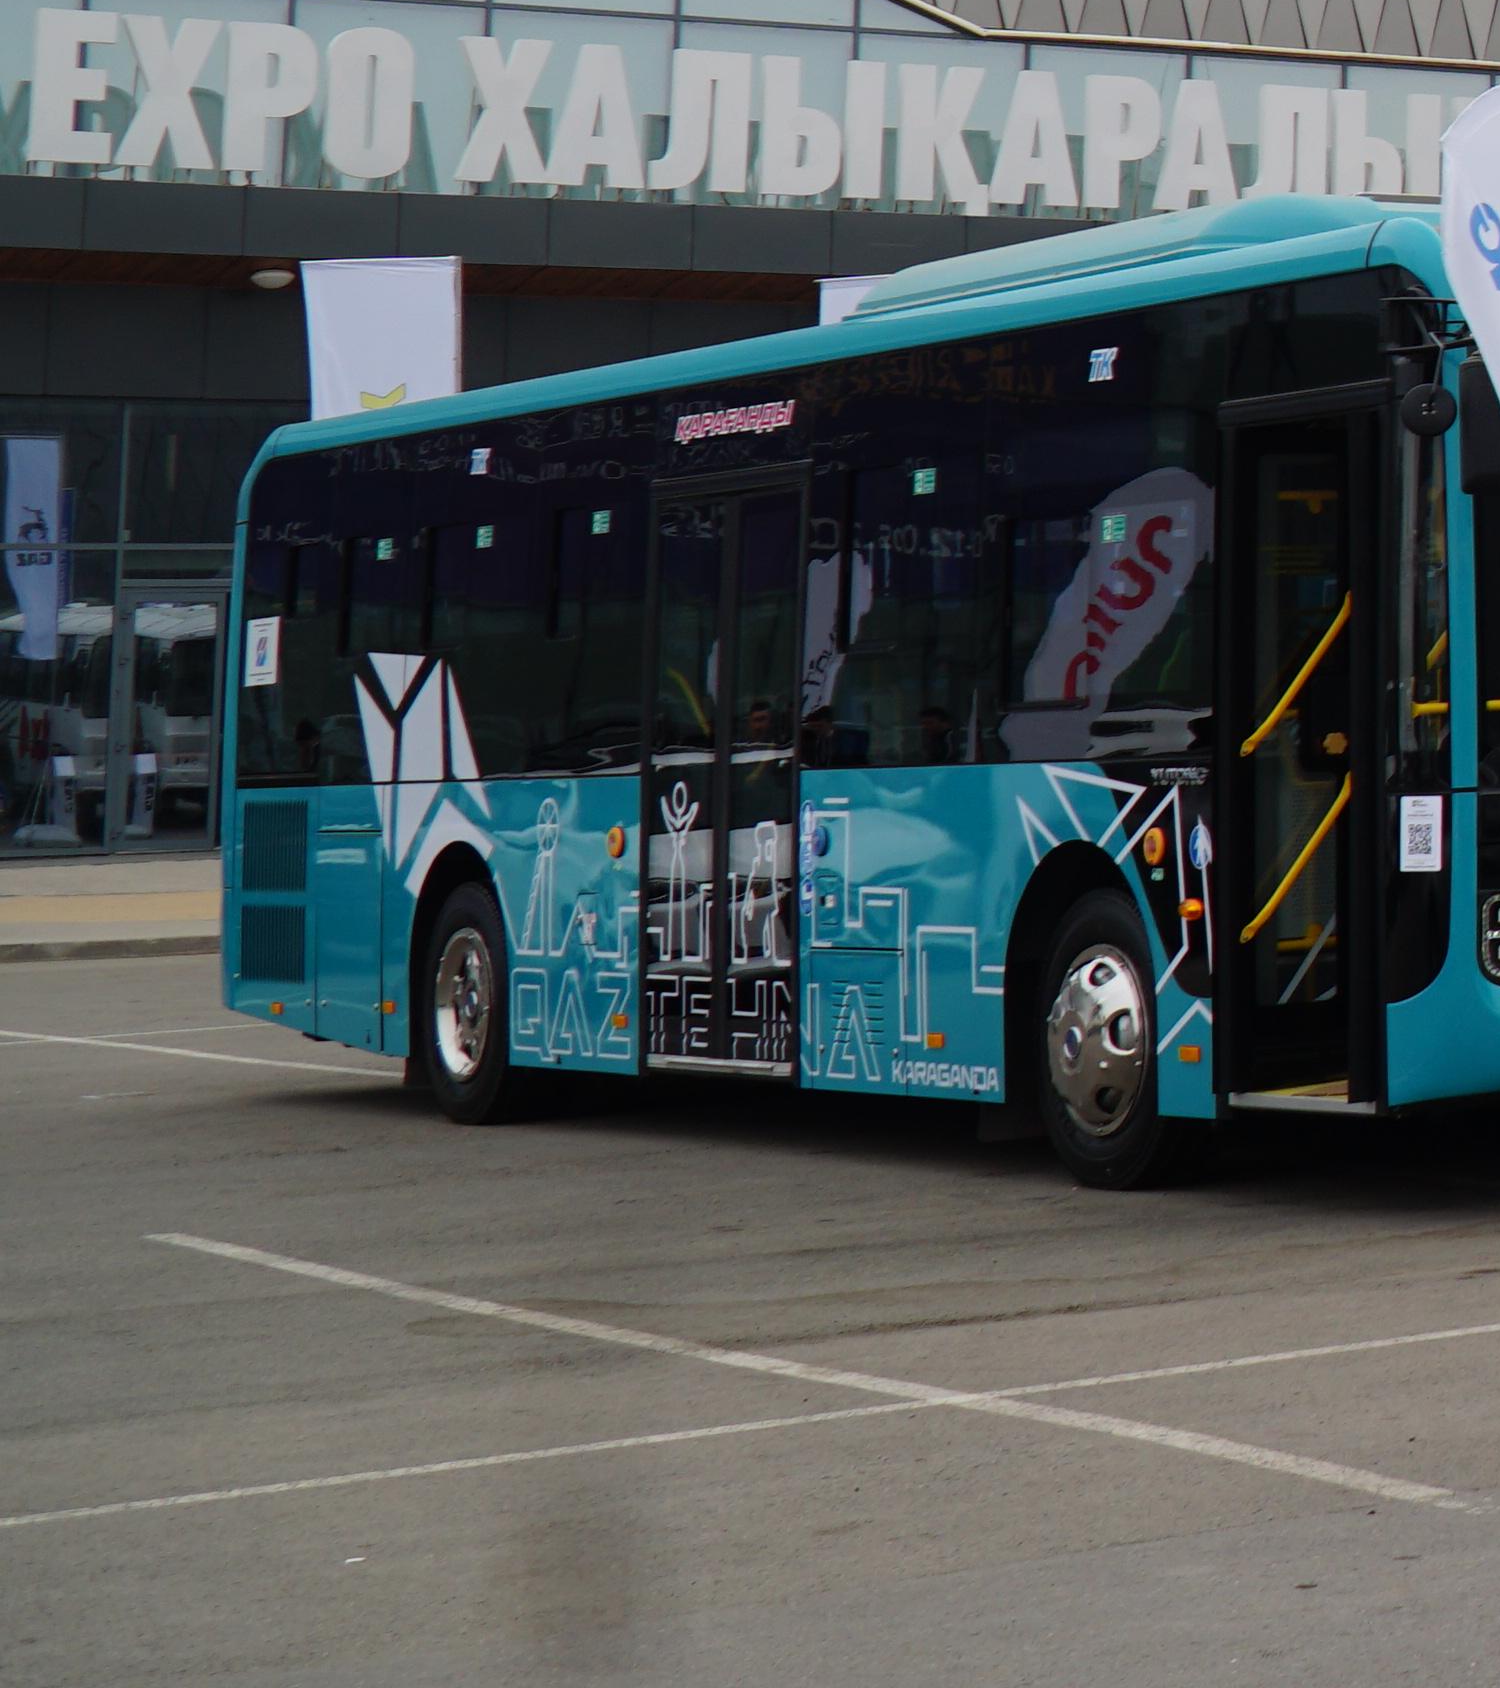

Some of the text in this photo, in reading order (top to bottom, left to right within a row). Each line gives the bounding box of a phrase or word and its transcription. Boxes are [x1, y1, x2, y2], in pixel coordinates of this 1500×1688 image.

[27, 7, 415, 180] EXPO
[454, 35, 1475, 216] ХАЛЫҚАРАЛЫ
[510, 967, 632, 1062] QAZ
[891, 1059, 1000, 1092] KARAGANDA
